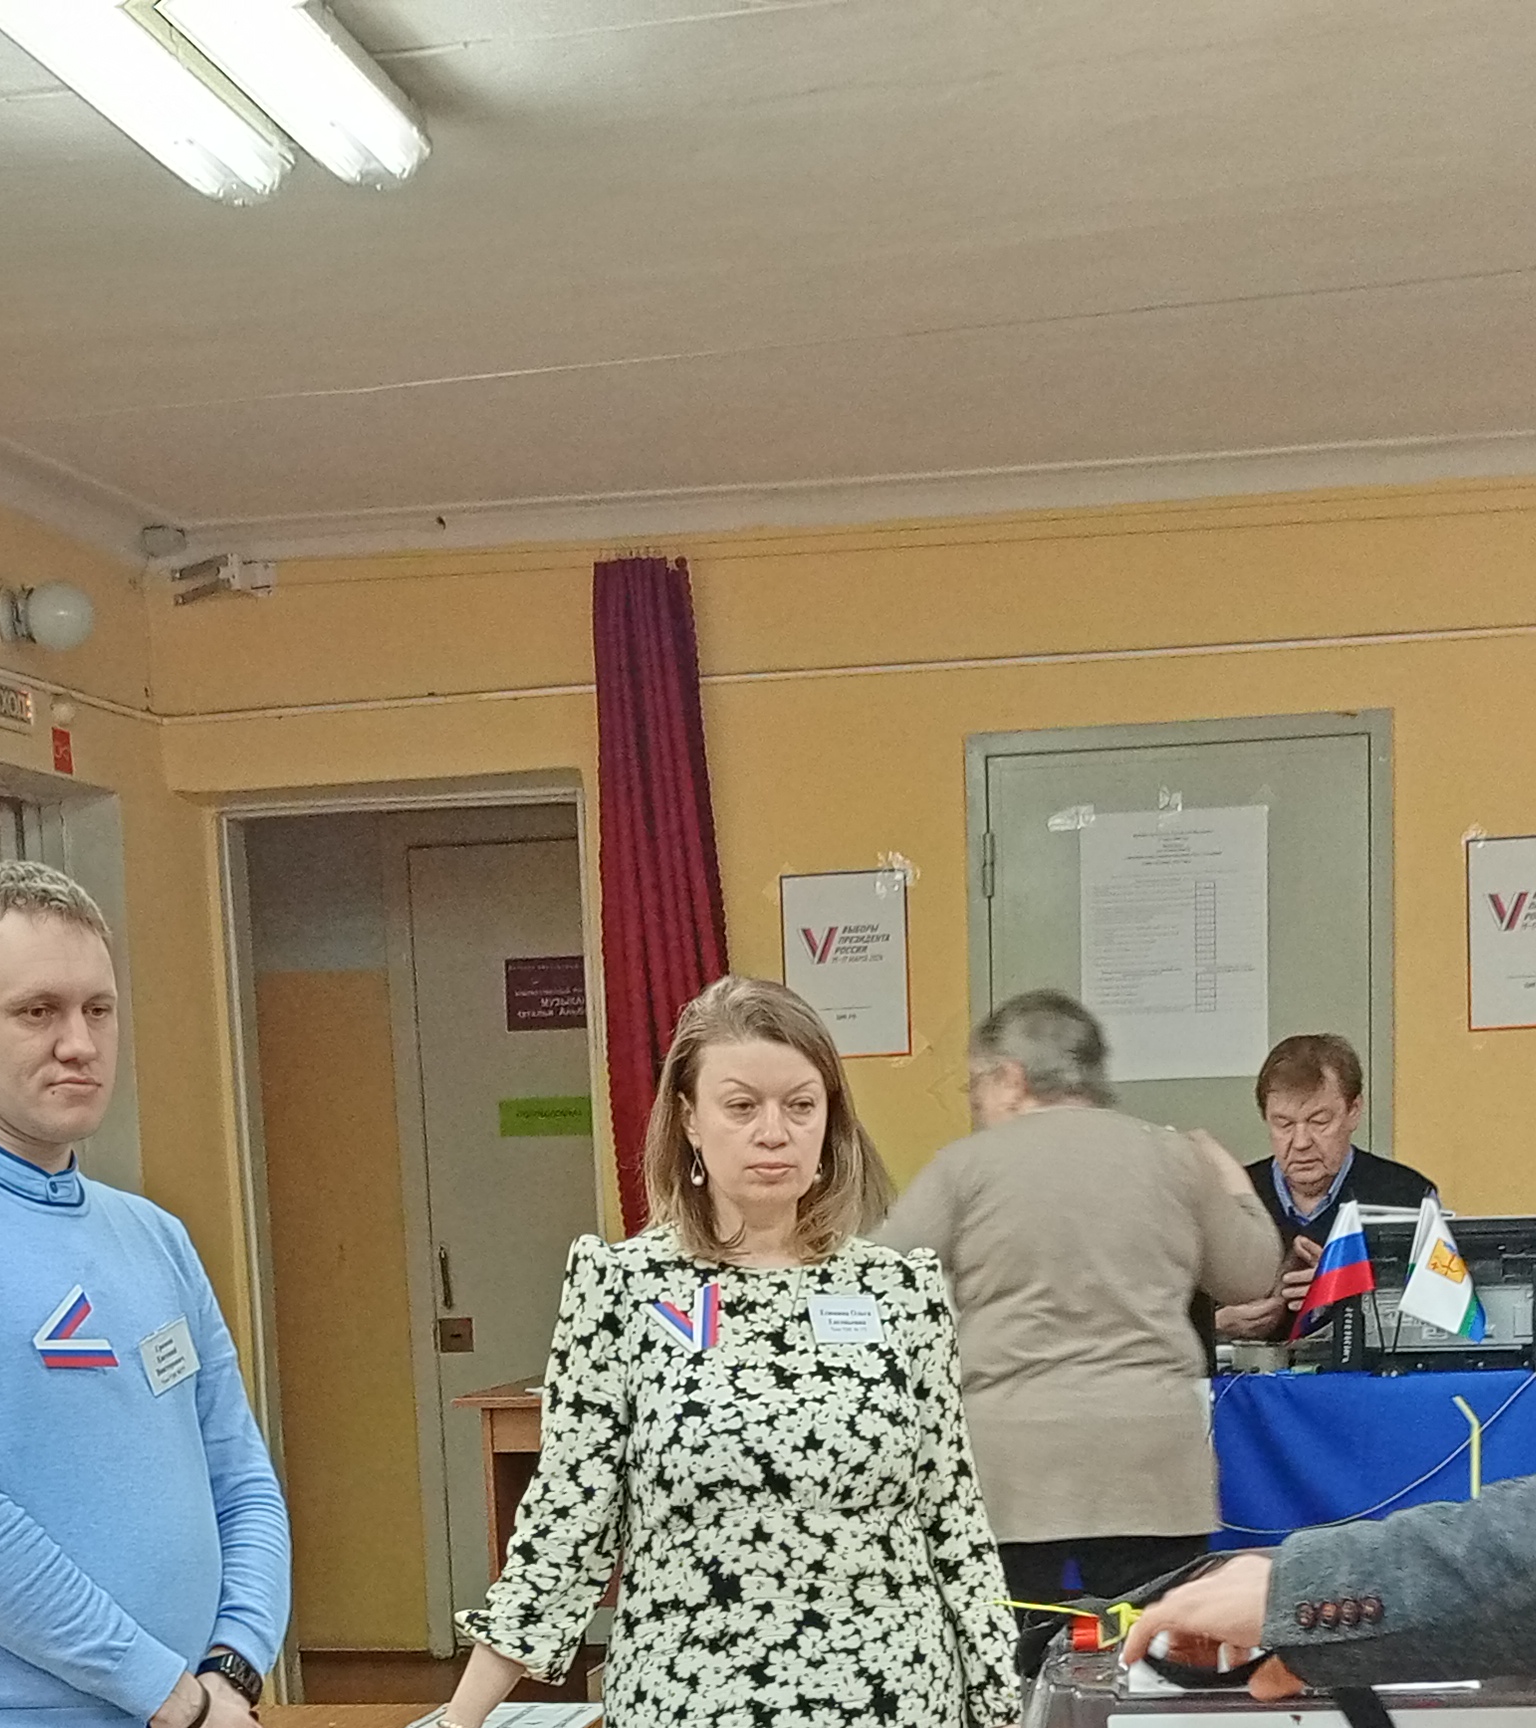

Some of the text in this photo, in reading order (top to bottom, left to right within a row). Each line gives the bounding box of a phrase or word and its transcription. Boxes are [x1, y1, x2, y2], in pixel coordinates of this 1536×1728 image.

[842, 925, 879, 934] ВЫБОРЫ
[838, 935, 890, 944] ПРЕЗИДЕНТА
[835, 946, 868, 954] РОССИИ
